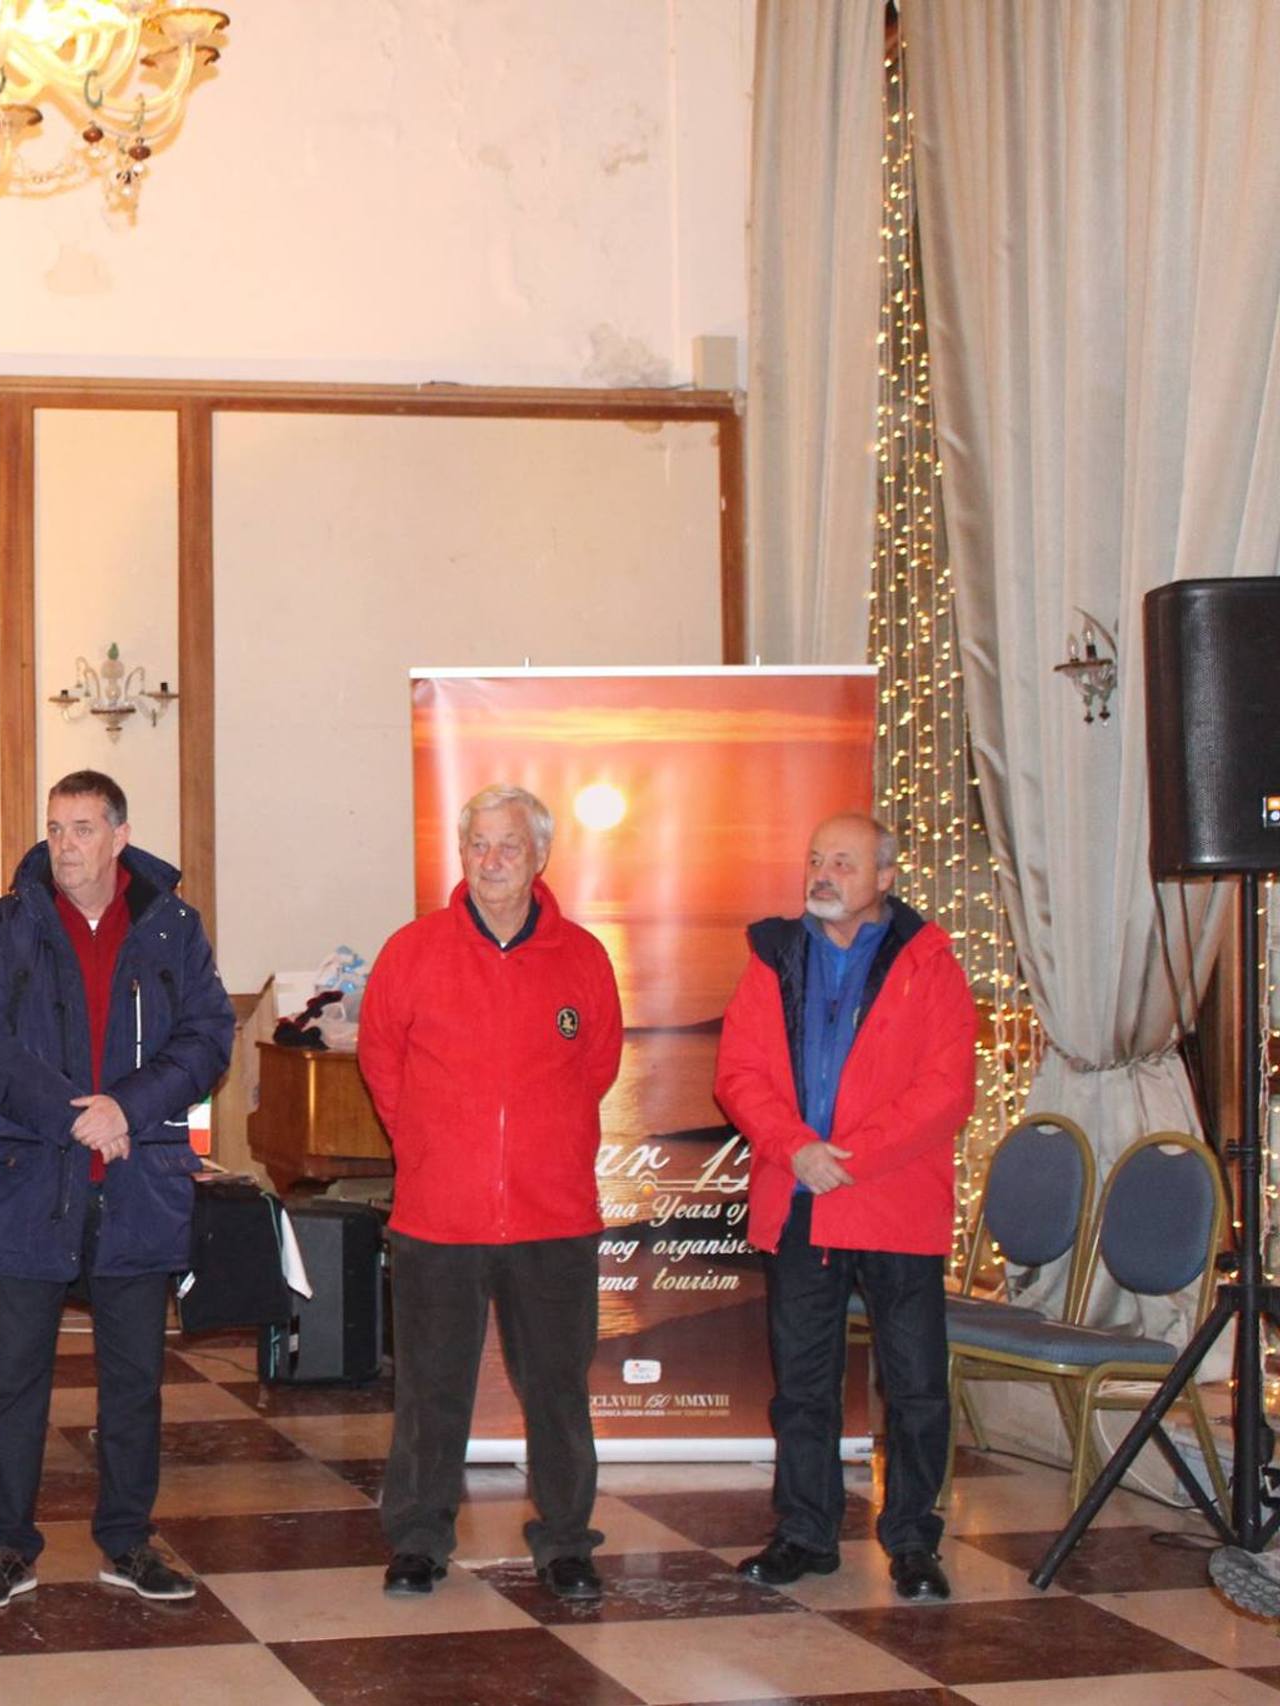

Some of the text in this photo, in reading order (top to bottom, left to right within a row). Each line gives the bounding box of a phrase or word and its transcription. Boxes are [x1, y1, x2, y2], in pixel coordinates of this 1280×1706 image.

[650, 1194, 722, 1227] Years
[652, 1233, 753, 1262] organise
[651, 1267, 740, 1291] tourism
